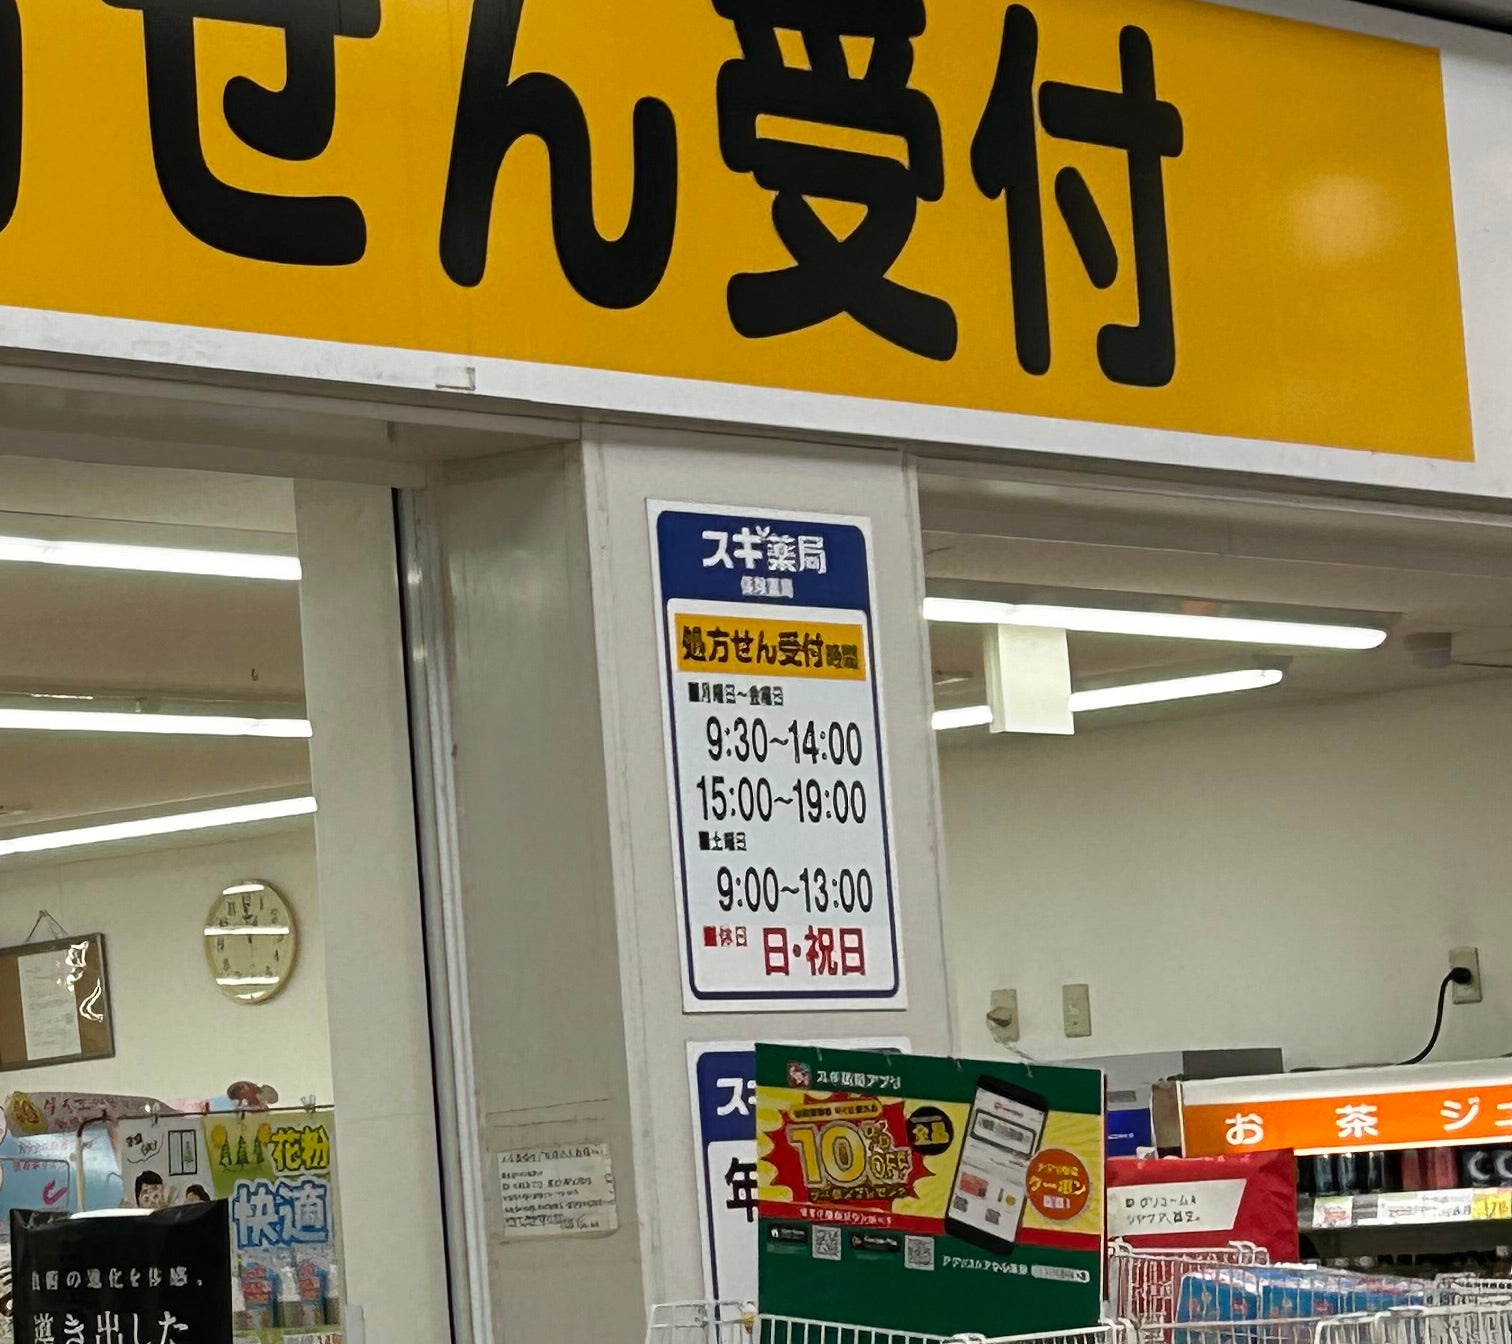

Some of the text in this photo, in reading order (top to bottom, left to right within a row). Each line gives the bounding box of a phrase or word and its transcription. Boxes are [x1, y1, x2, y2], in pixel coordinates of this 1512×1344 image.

[701, 526, 828, 576] スギ薬局
[681, 626, 859, 671] 処方せん受付時間
[762, 925, 867, 977] 日・祝日
[269, 1125, 331, 1172] 花粉
[232, 1180, 331, 1251] 快適
